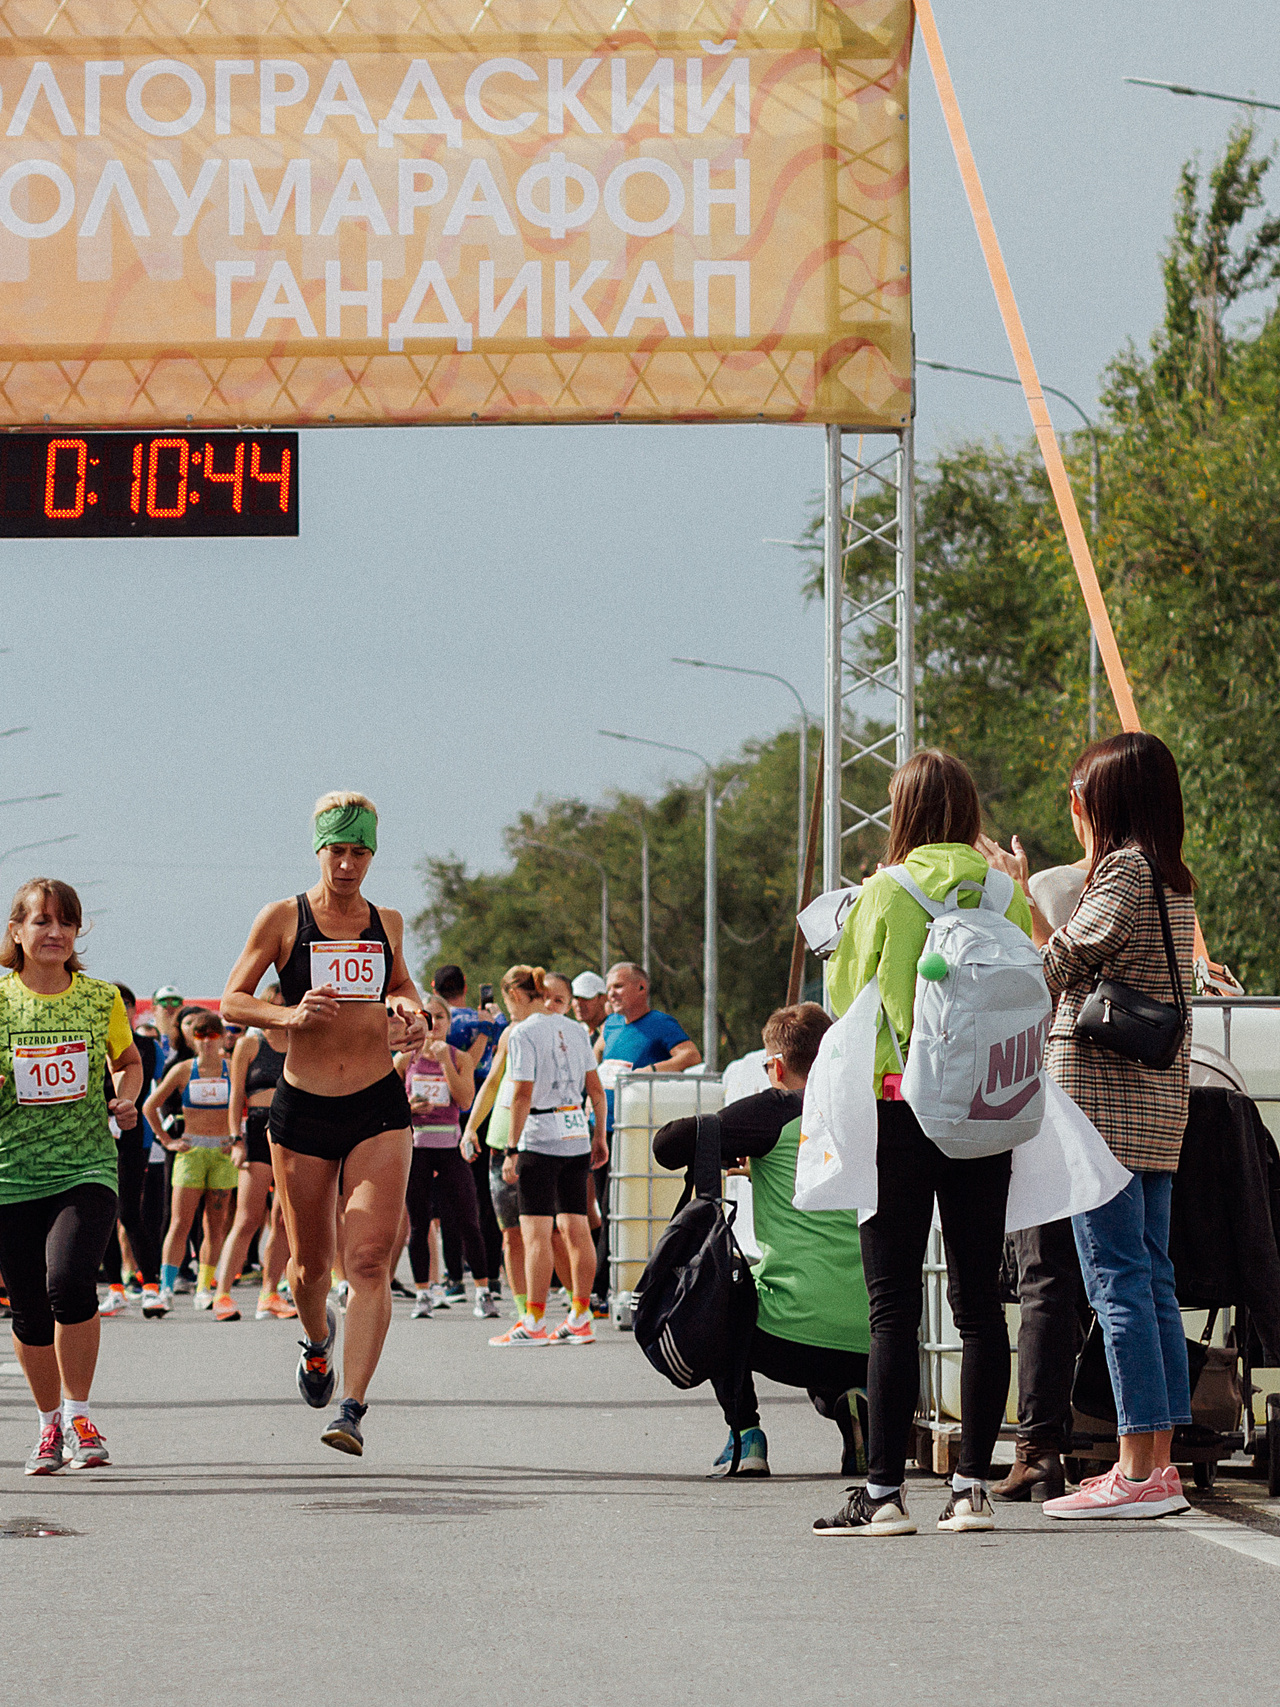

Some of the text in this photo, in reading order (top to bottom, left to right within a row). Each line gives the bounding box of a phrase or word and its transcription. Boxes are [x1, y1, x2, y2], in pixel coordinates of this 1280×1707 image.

[214, 260, 751, 352] ГАНДИКАП
[44, 439, 291, 518] 0:10:44
[328, 958, 374, 983] 105
[17, 1035, 58, 1046] BEZROAD
[29, 1059, 77, 1087] 103
